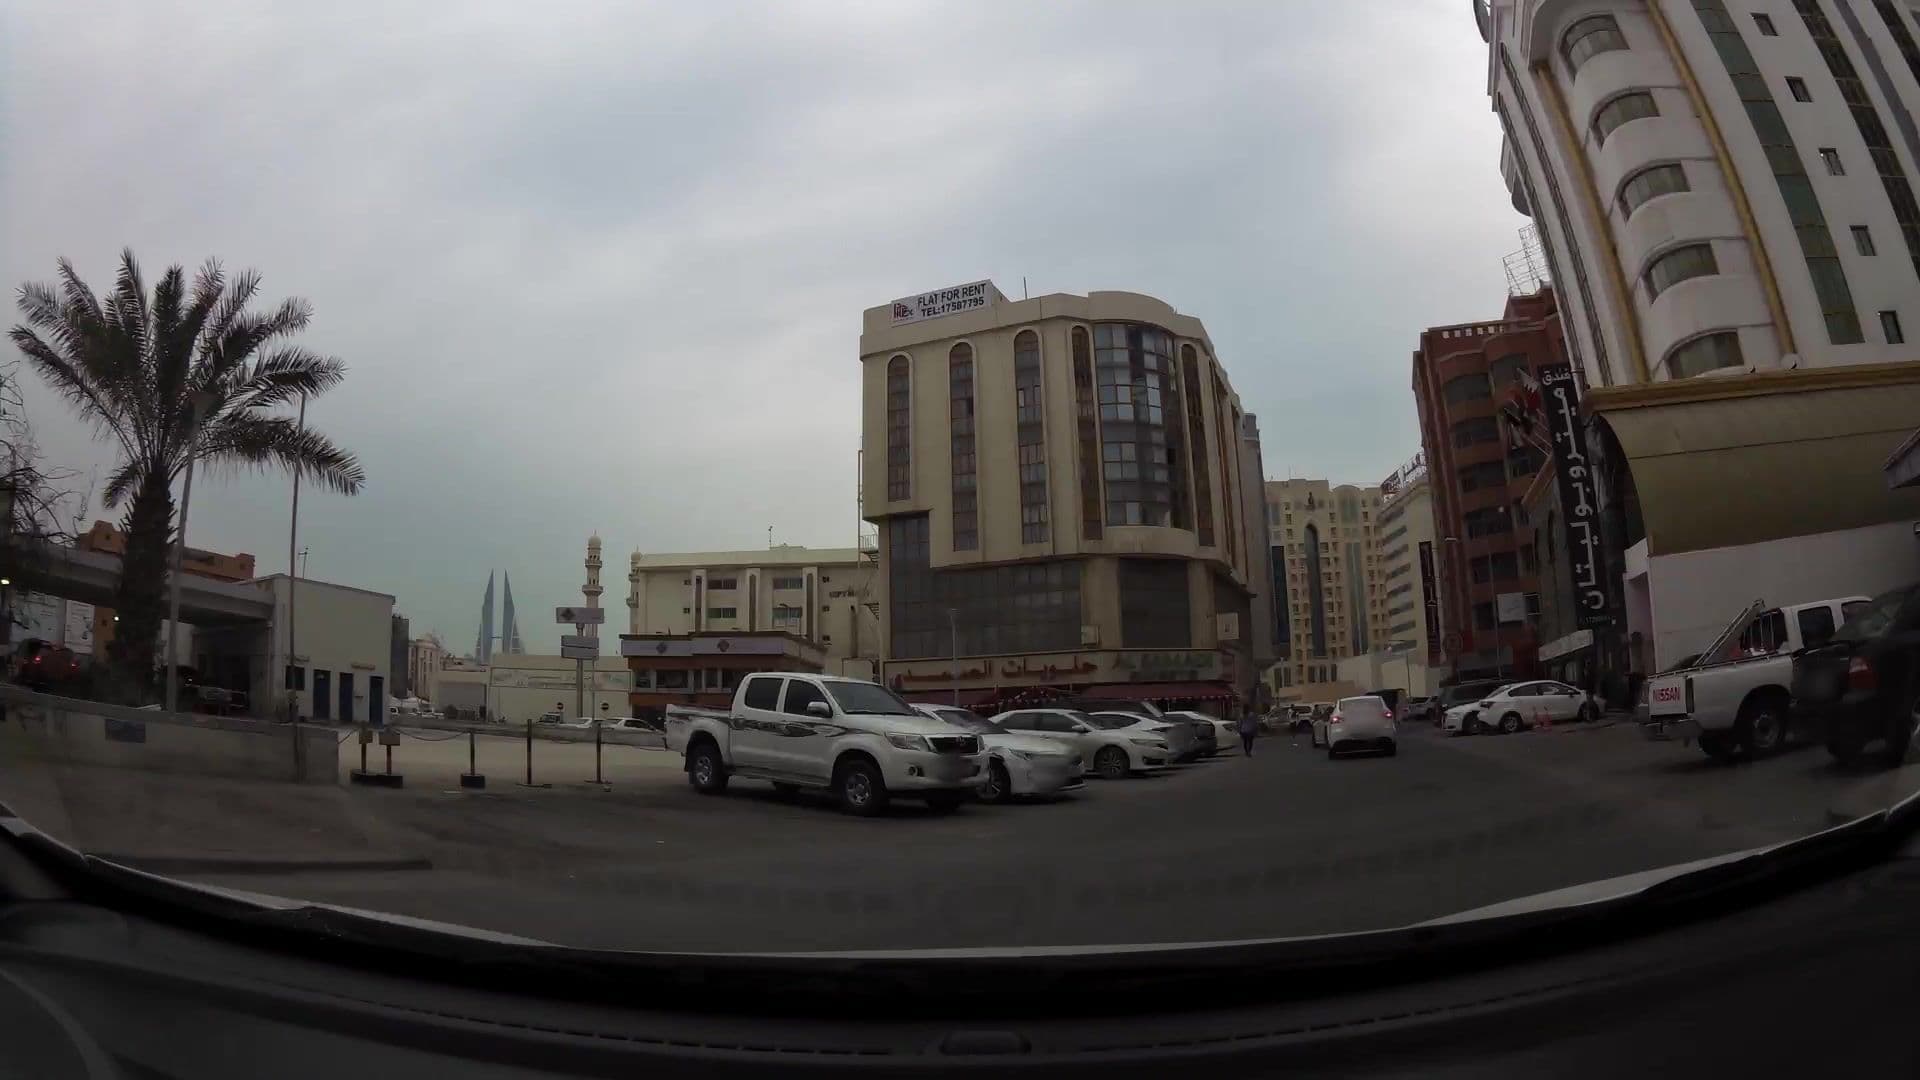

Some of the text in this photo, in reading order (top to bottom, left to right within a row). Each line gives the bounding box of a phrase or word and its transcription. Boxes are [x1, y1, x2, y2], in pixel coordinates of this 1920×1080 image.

[917, 283, 986, 308] FLAT FOR RENT
[1652, 686, 1681, 702] NISSAN
